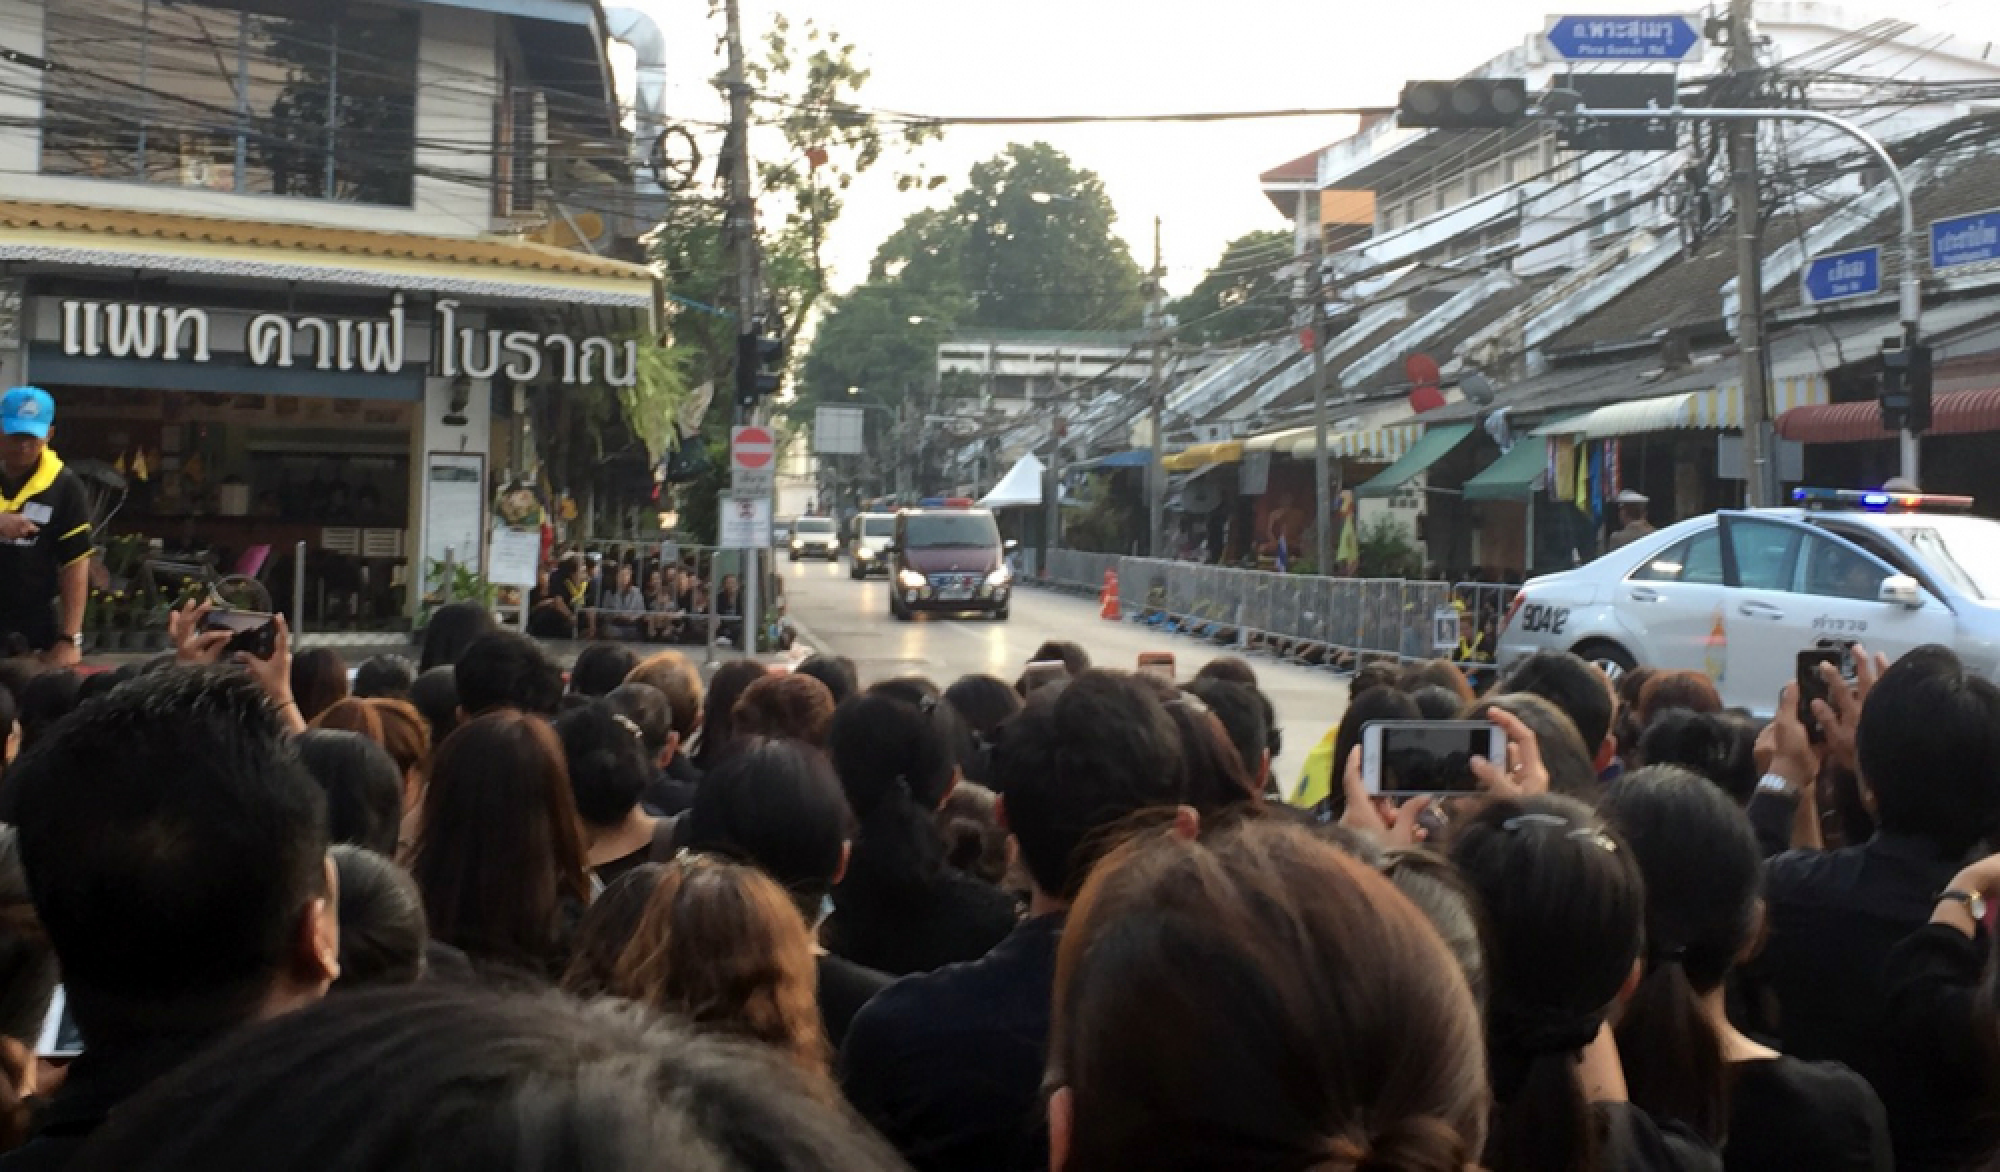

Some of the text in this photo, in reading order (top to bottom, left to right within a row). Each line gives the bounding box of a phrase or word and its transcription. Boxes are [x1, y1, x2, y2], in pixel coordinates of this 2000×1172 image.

[62, 300, 211, 362] แพท
[248, 293, 404, 373] คาเฟ่
[436, 298, 637, 387] โบราณ
